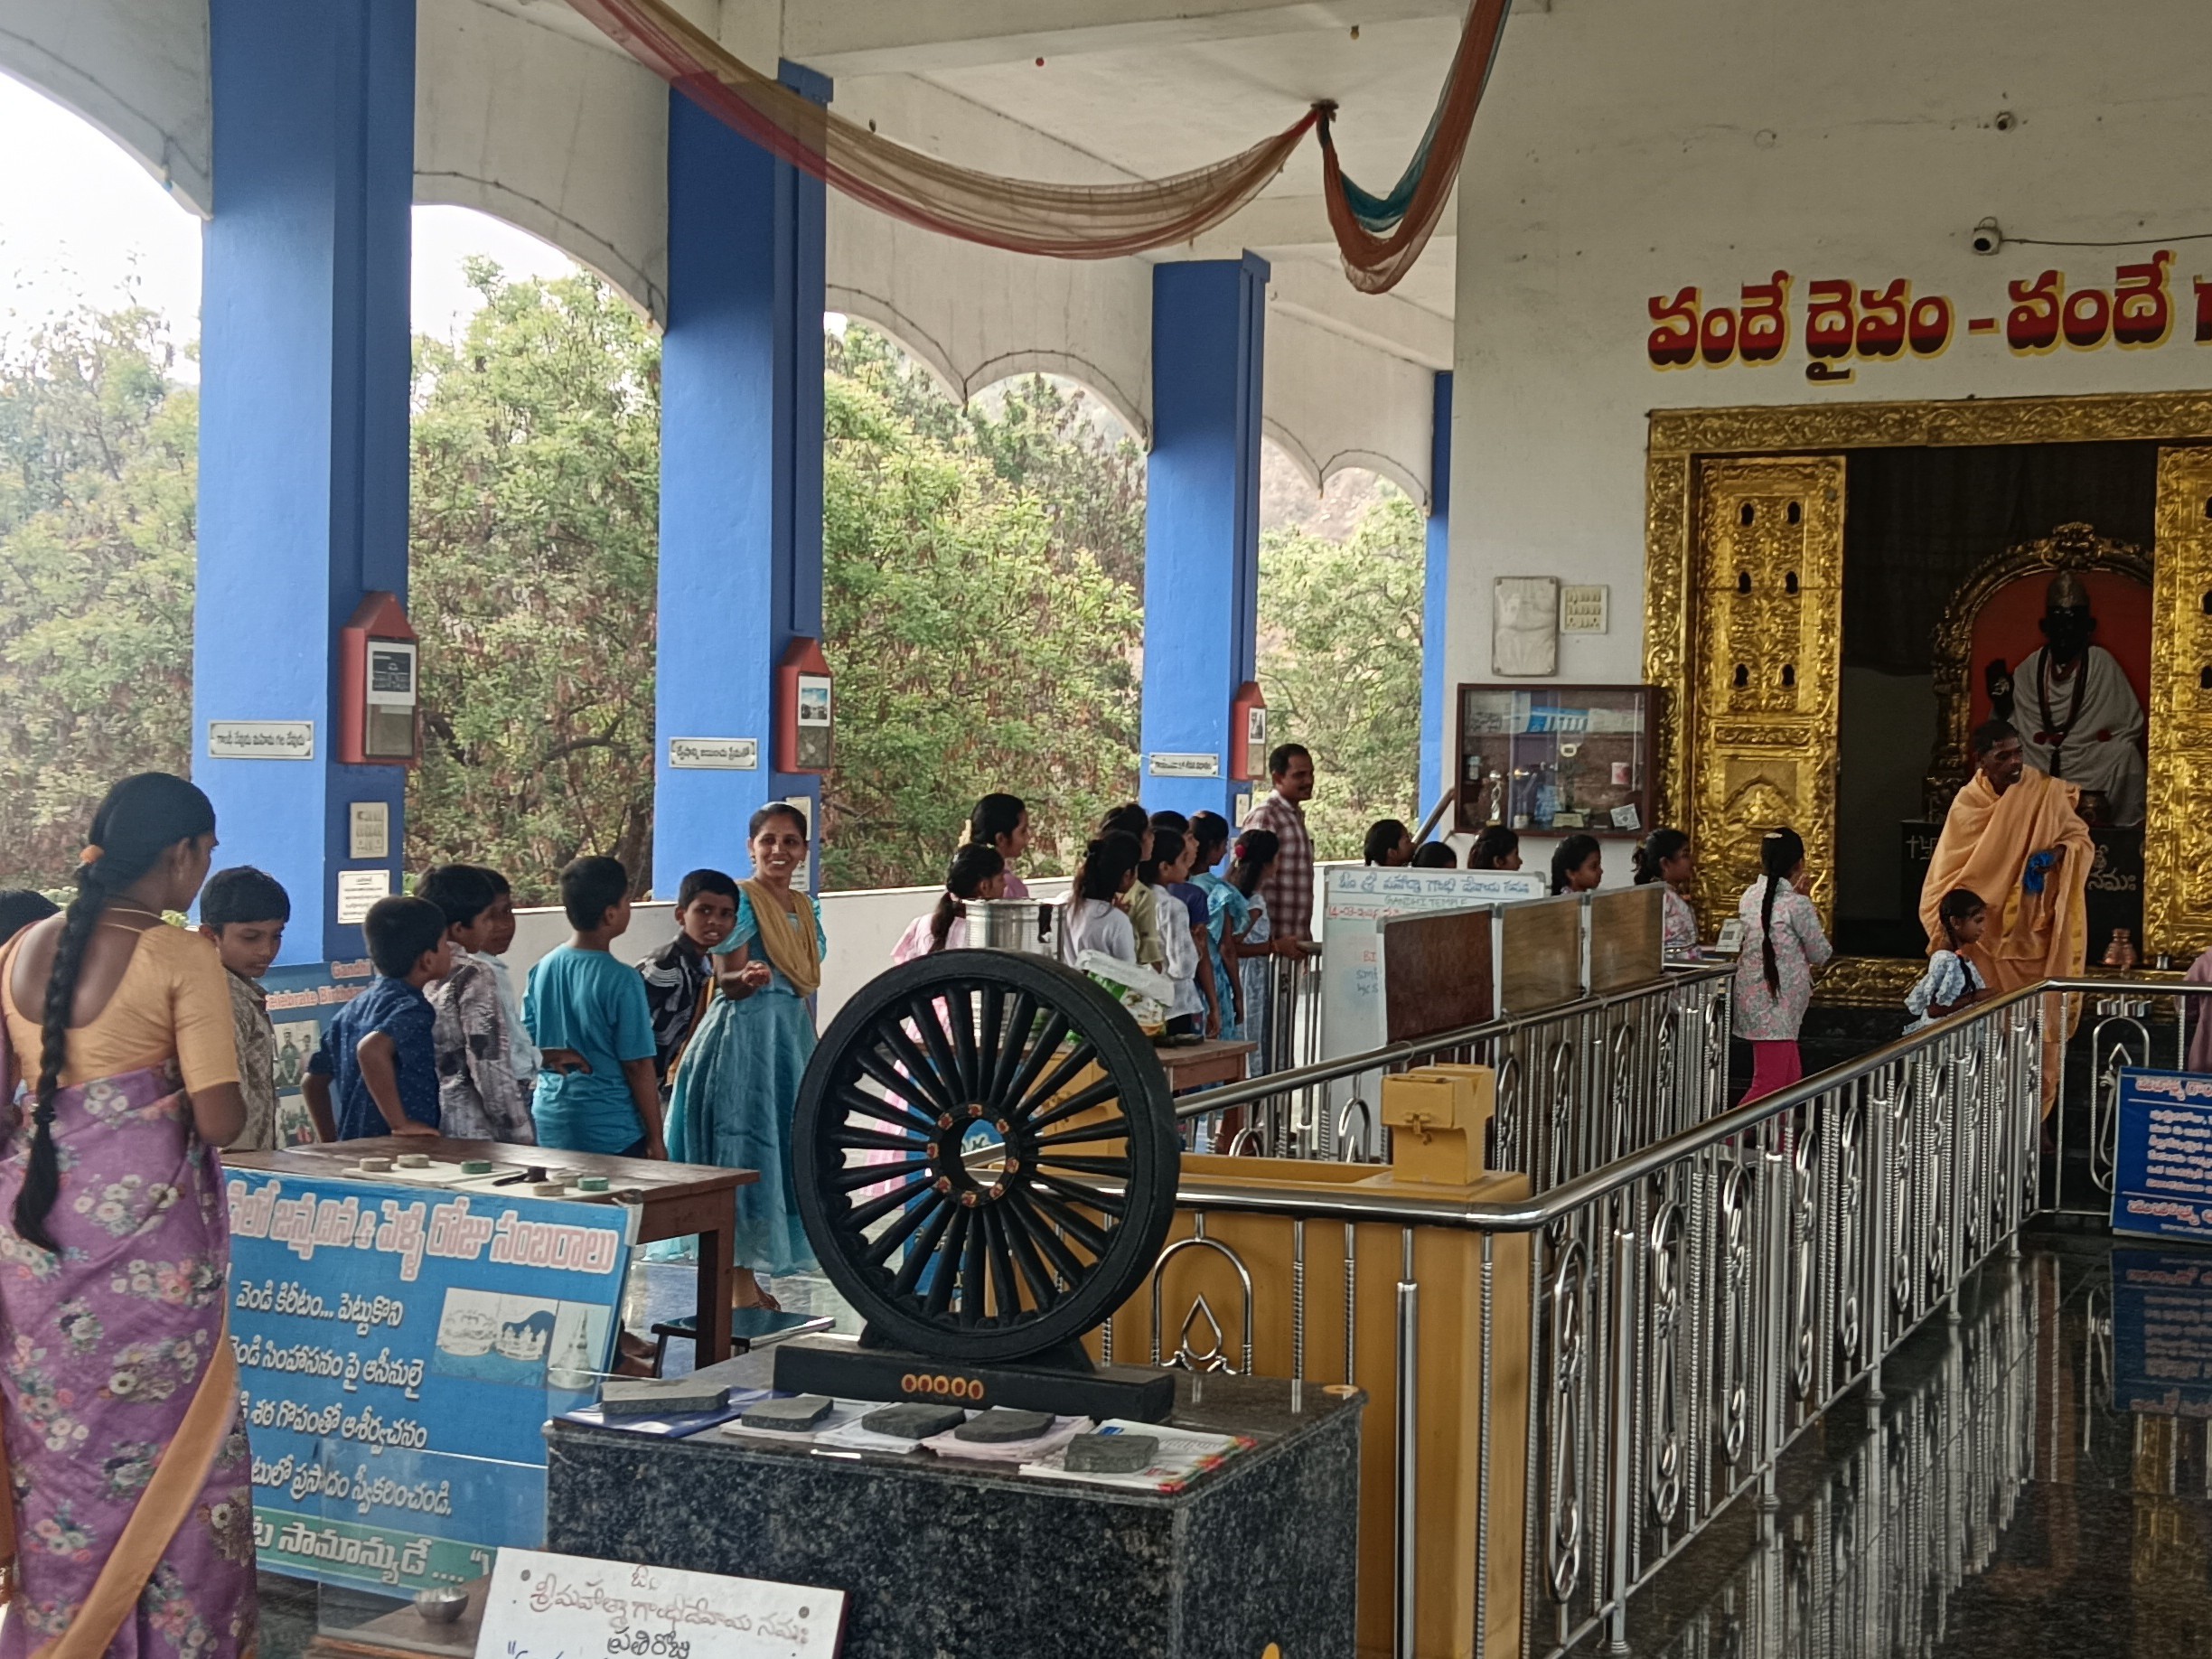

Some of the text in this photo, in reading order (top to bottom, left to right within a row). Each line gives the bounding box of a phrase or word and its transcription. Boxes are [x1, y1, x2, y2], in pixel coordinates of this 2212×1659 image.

[1647, 270, 1794, 370] వందే
[1805, 277, 1954, 385] దైవం
[265, 988, 318, 1011] elebrate
[426, 1195, 493, 1260] రోజు
[489, 1209, 619, 1274] సంబరాలు
[236, 1279, 273, 1309] వెండి
